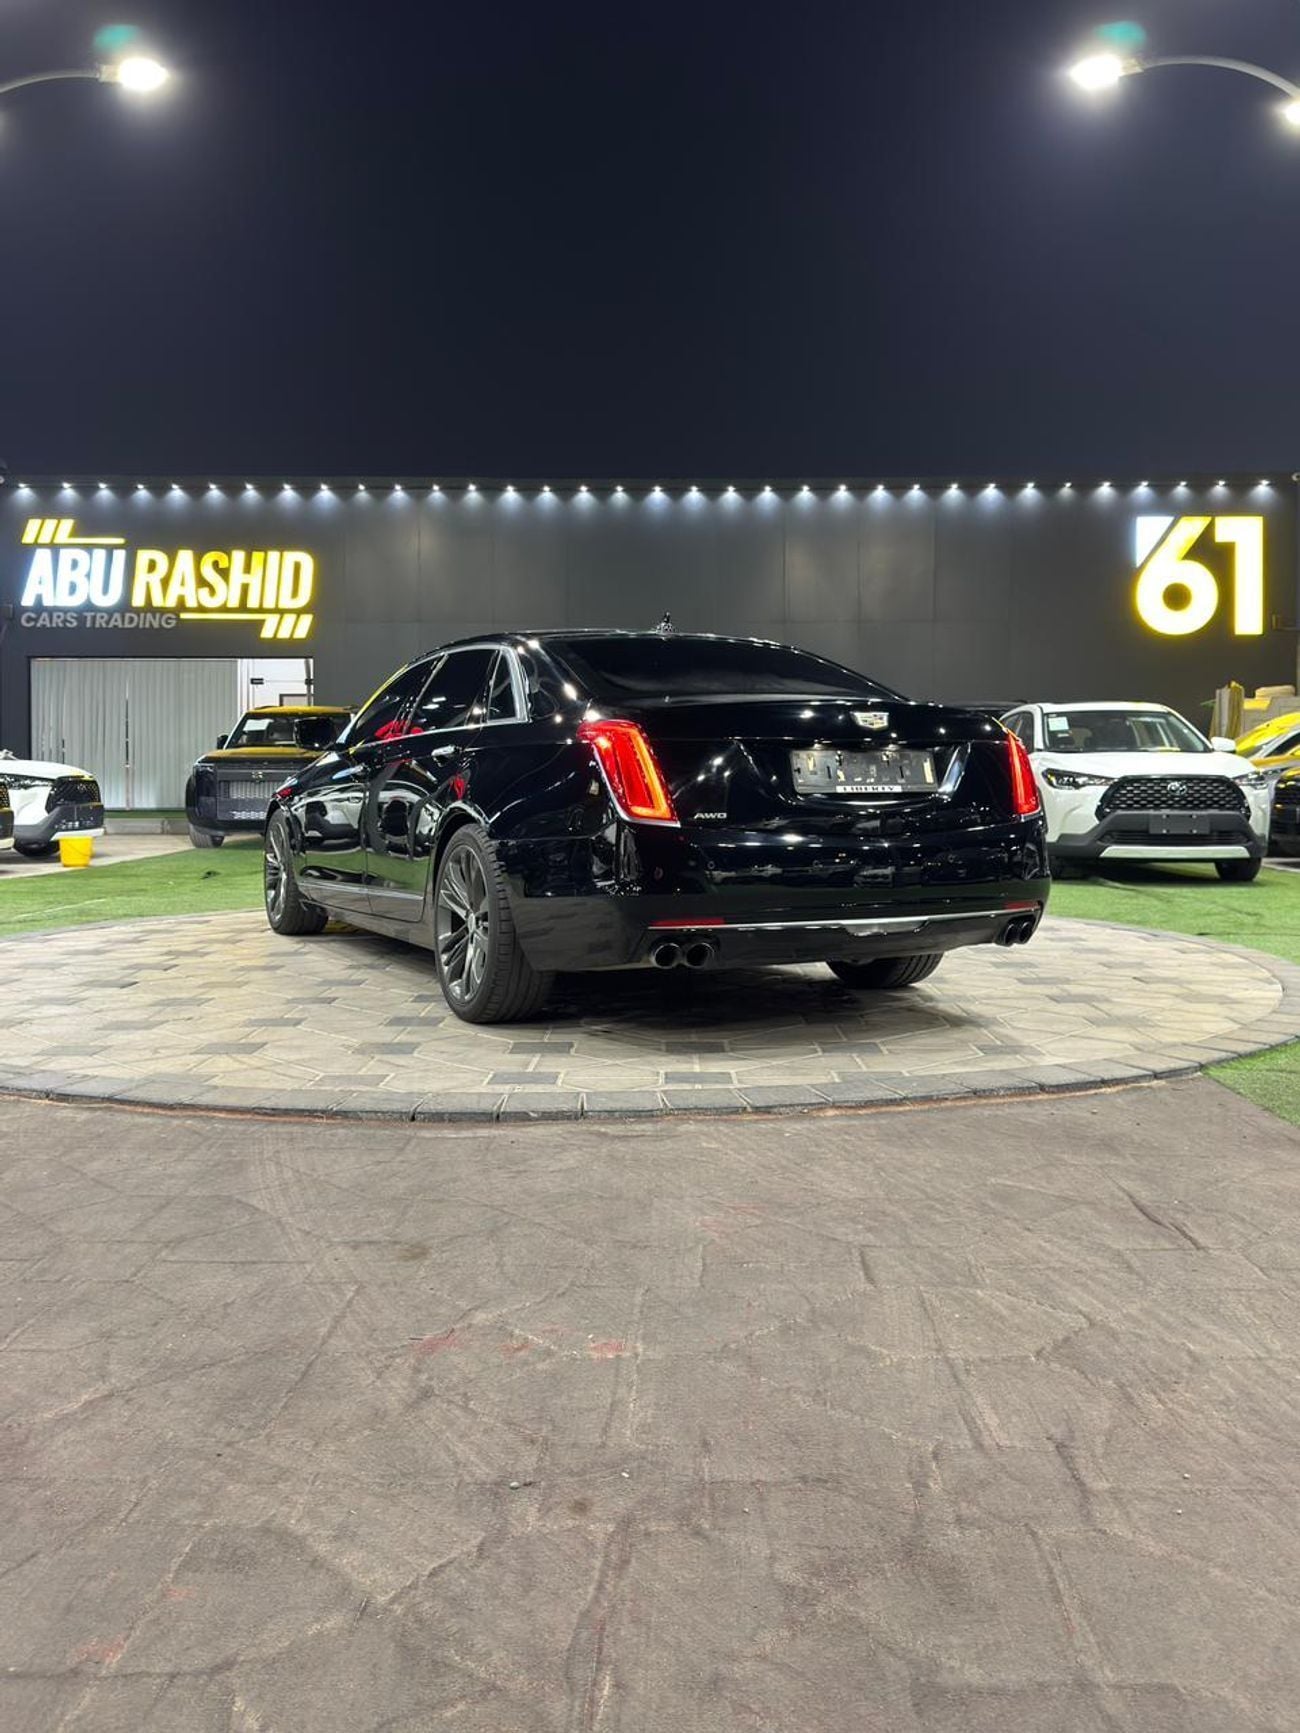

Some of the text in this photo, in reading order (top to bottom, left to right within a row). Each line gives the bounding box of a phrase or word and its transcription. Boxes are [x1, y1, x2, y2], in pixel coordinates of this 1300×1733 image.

[20, 549, 315, 609] ABU RASHID
[1135, 515, 1264, 636] 61
[20, 612, 177, 629] CARS TRADING
